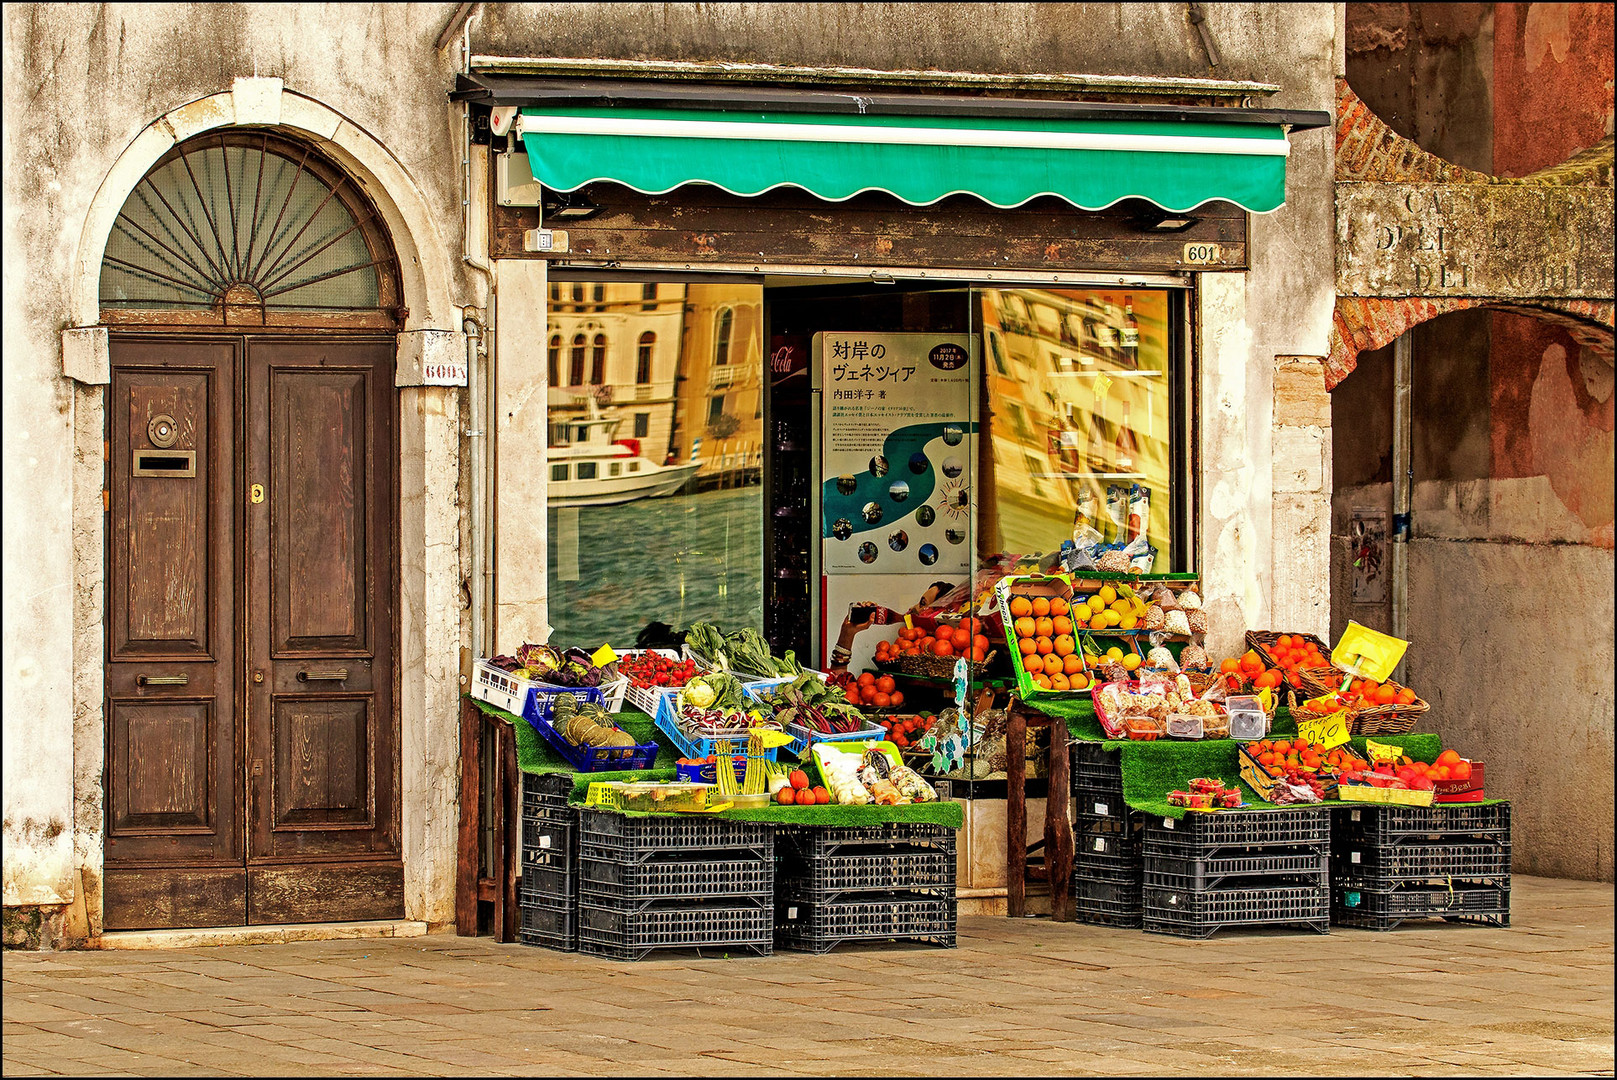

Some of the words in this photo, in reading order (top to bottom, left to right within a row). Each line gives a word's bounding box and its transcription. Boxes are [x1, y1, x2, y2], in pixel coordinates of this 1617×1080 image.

[1189, 246, 1213, 261] 601
[832, 340, 886, 360] 対岸の
[833, 363, 916, 382] ヴェネツィア
[833, 389, 875, 400] 内田洋子
[878, 390, 887, 400] 著
[1450, 781, 1472, 793] Best
